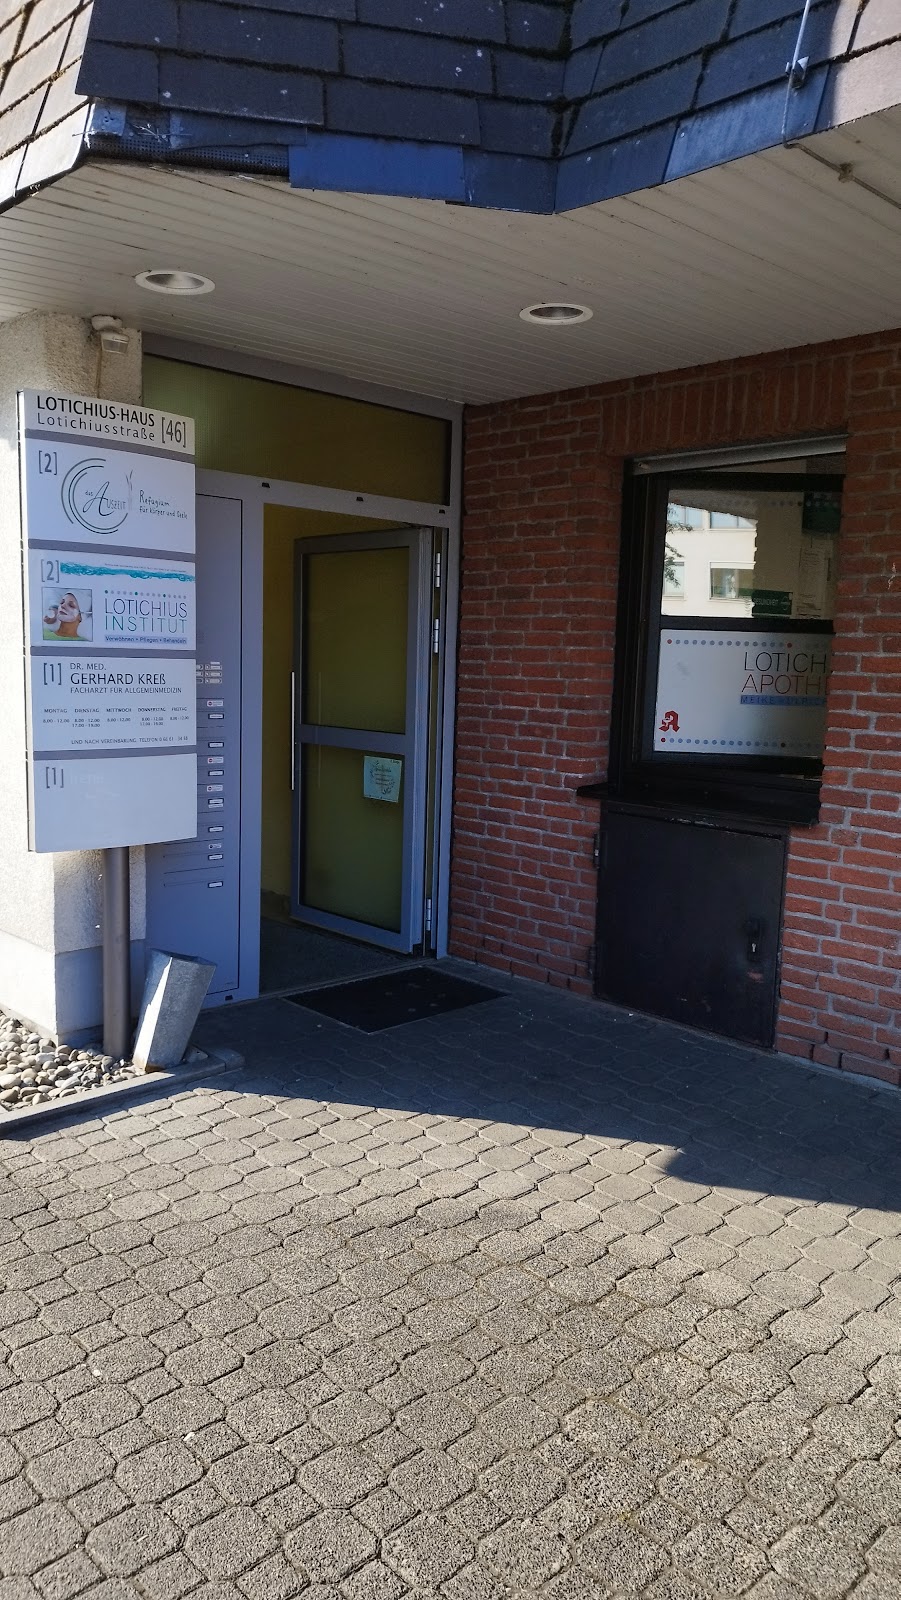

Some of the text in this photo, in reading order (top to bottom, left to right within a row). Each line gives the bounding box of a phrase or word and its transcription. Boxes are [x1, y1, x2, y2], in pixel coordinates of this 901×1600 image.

[37, 395, 155, 427] LOTICHIUS-HAUS
[37, 412, 155, 441] Lotichiusstraße
[161, 416, 186, 448] [46]
[38, 450, 58, 476] [2]
[139, 489, 170, 508] Refugium
[40, 558, 60, 584] [2]
[105, 598, 188, 618] LOTICHIUS
[105, 615, 188, 634] INSTITUT
[43, 662, 62, 686] [1]
[70, 672, 134, 685] GERHARD
[45, 766, 64, 789] [1]
